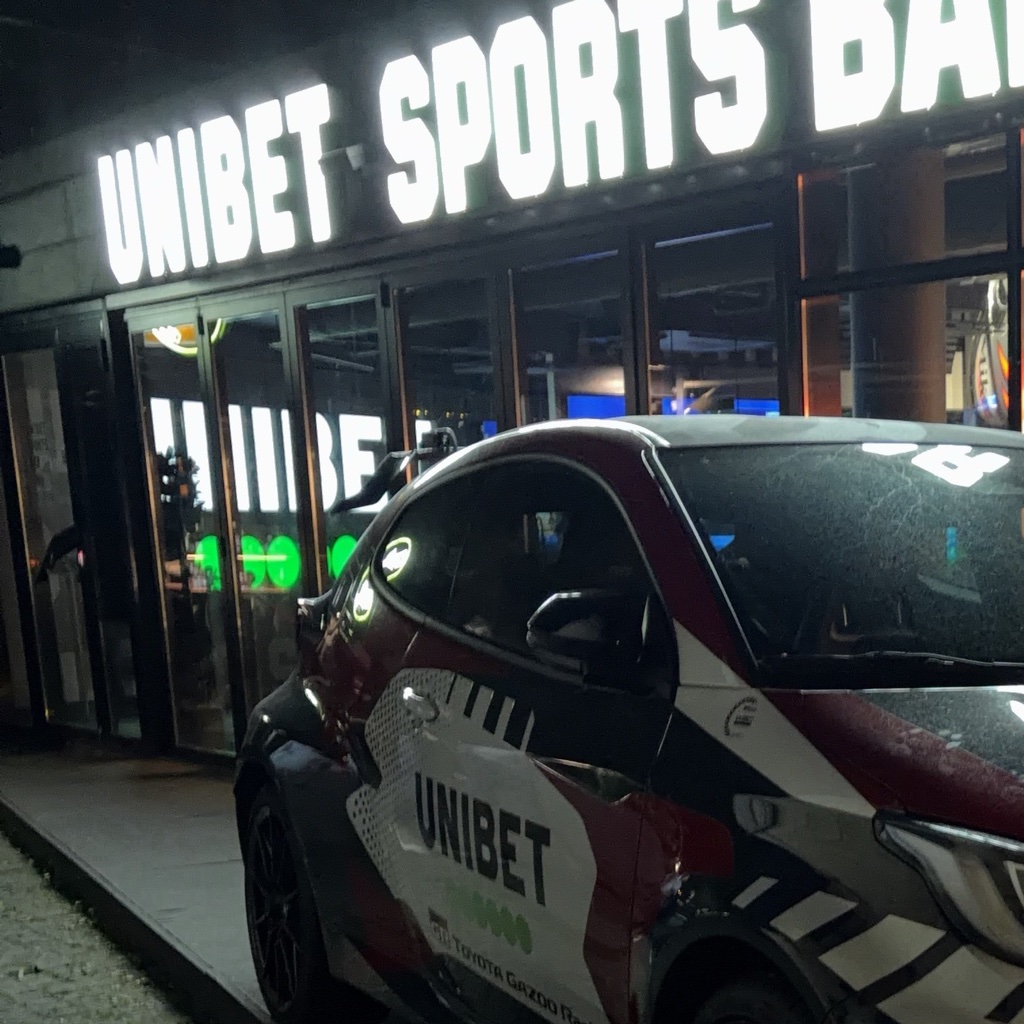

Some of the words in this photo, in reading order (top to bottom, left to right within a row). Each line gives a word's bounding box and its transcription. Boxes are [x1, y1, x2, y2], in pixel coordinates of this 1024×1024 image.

[97, 83, 331, 285] UNIBET
[379, 0, 768, 225] SPORTS
[415, 771, 551, 907] UNIBET
[452, 933, 504, 982] TOYOTA
[506, 970, 558, 1016] GAZOO
